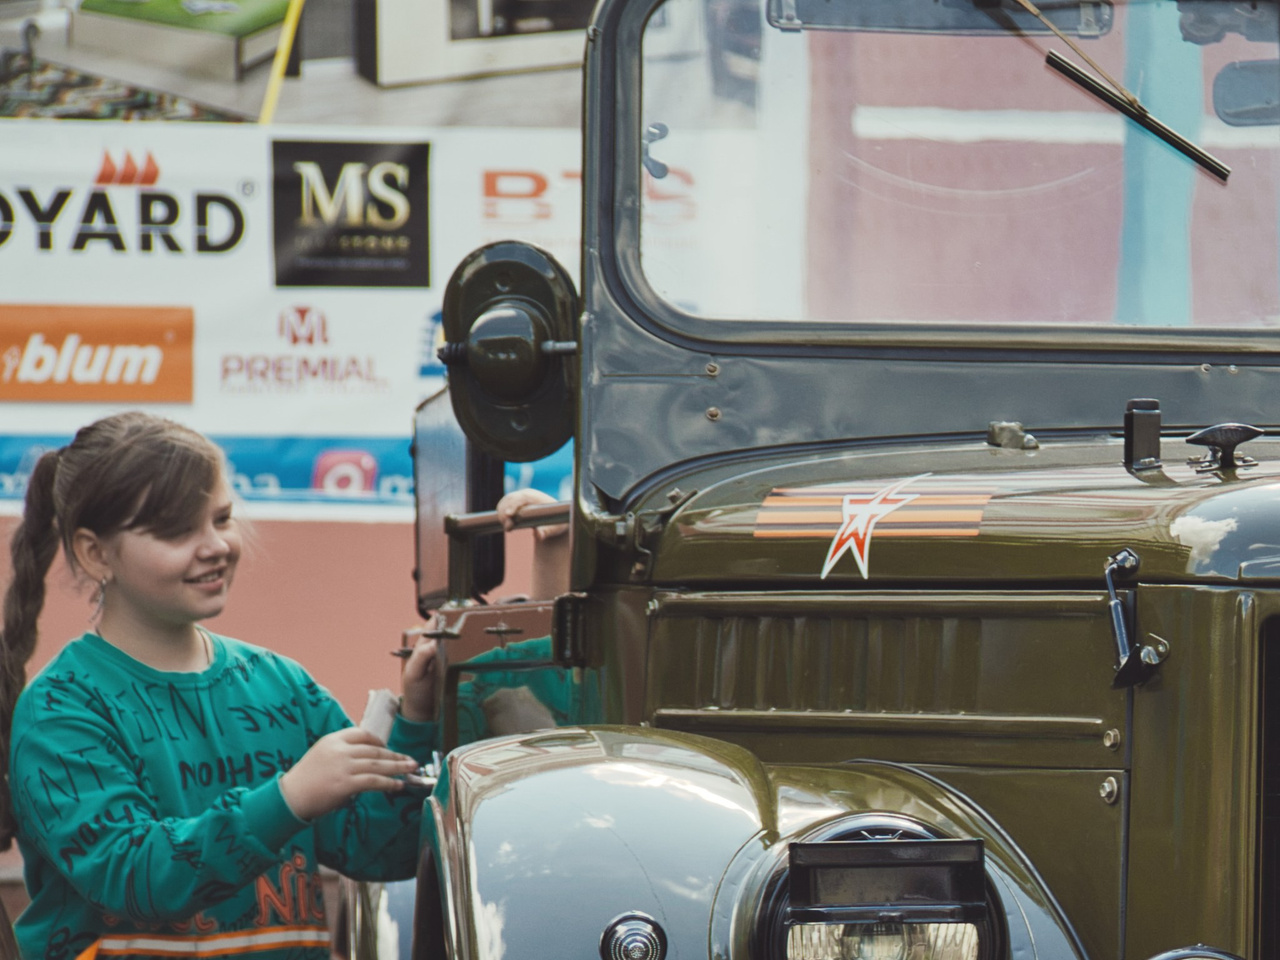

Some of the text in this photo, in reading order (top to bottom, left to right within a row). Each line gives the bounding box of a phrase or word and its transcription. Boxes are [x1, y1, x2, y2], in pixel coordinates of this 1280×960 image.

[0, 187, 245, 252] YARD
[293, 161, 411, 231] MS
[17, 332, 163, 384] blum
